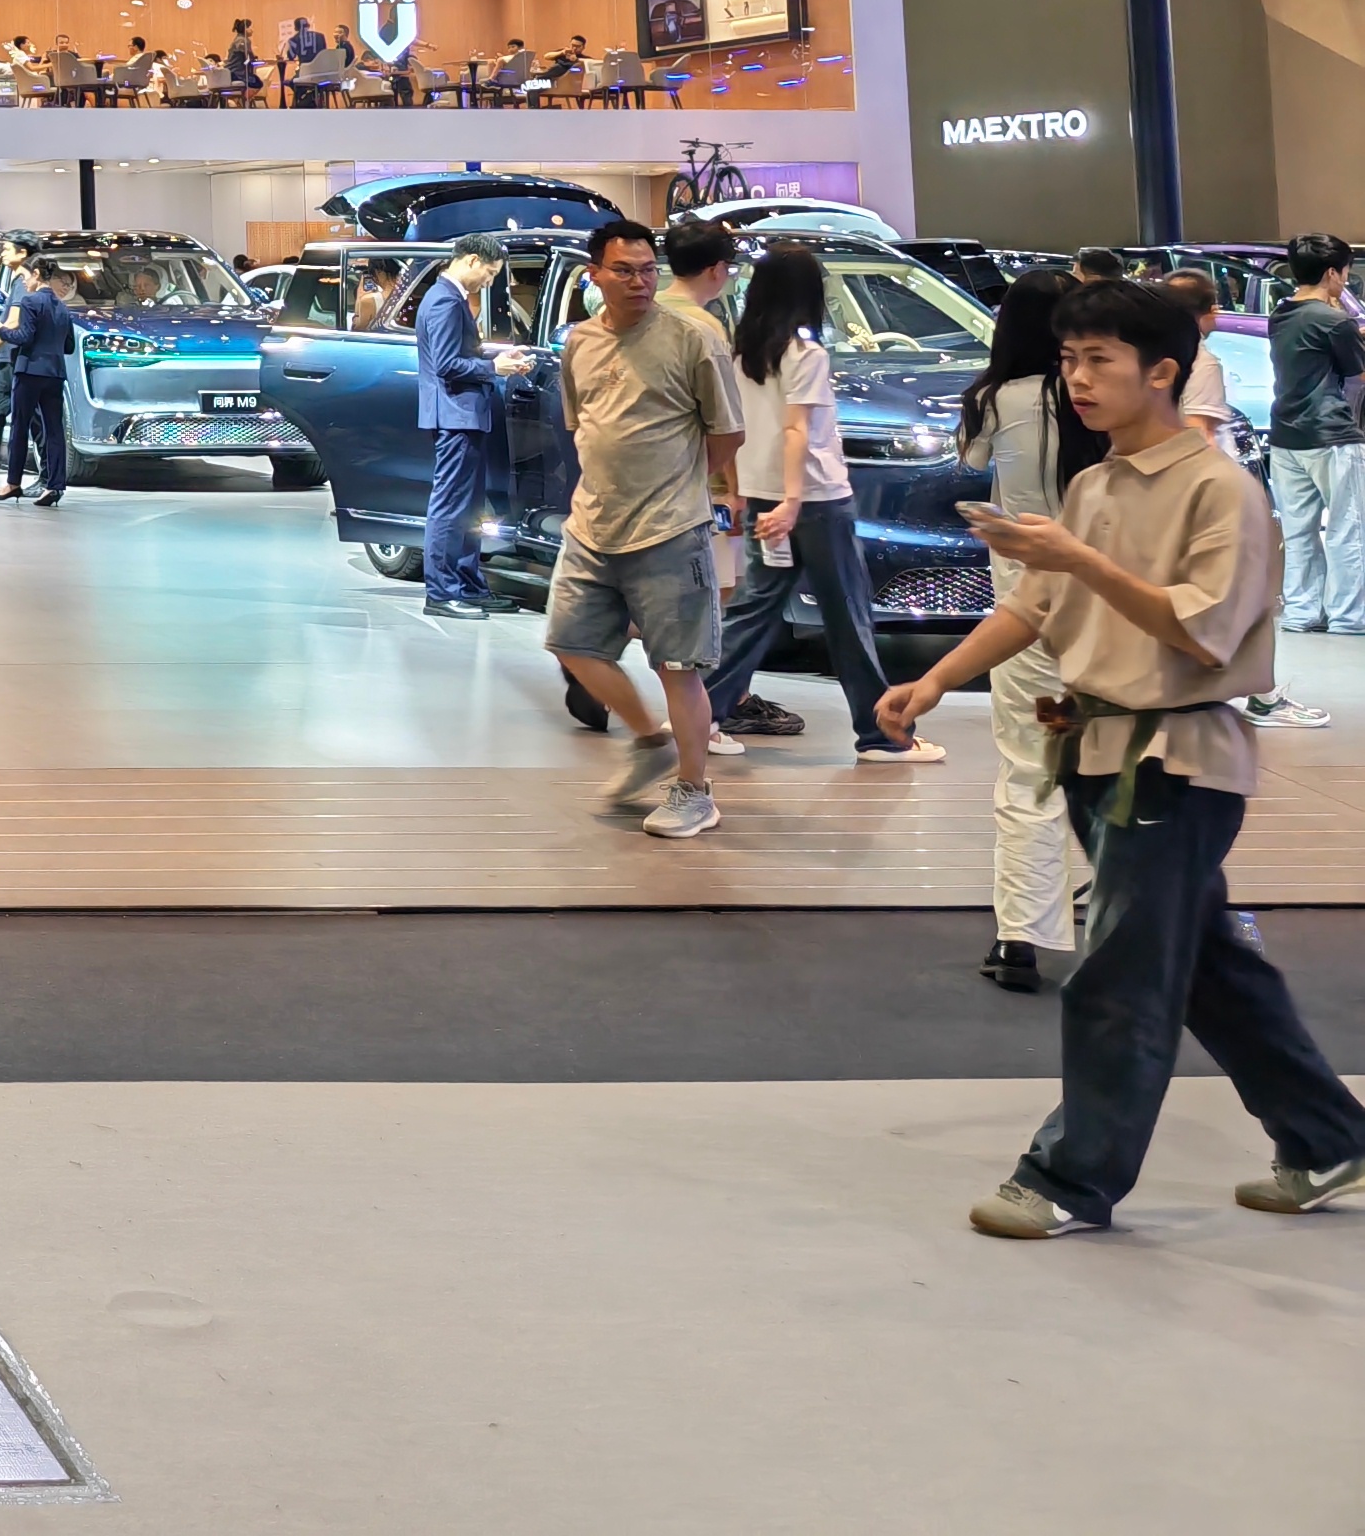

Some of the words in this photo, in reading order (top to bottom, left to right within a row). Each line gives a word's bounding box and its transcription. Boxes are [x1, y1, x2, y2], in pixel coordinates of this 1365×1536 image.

[942, 109, 1087, 145] MAEXTRO
[214, 396, 234, 408] 问界
[237, 396, 257, 408] M9
